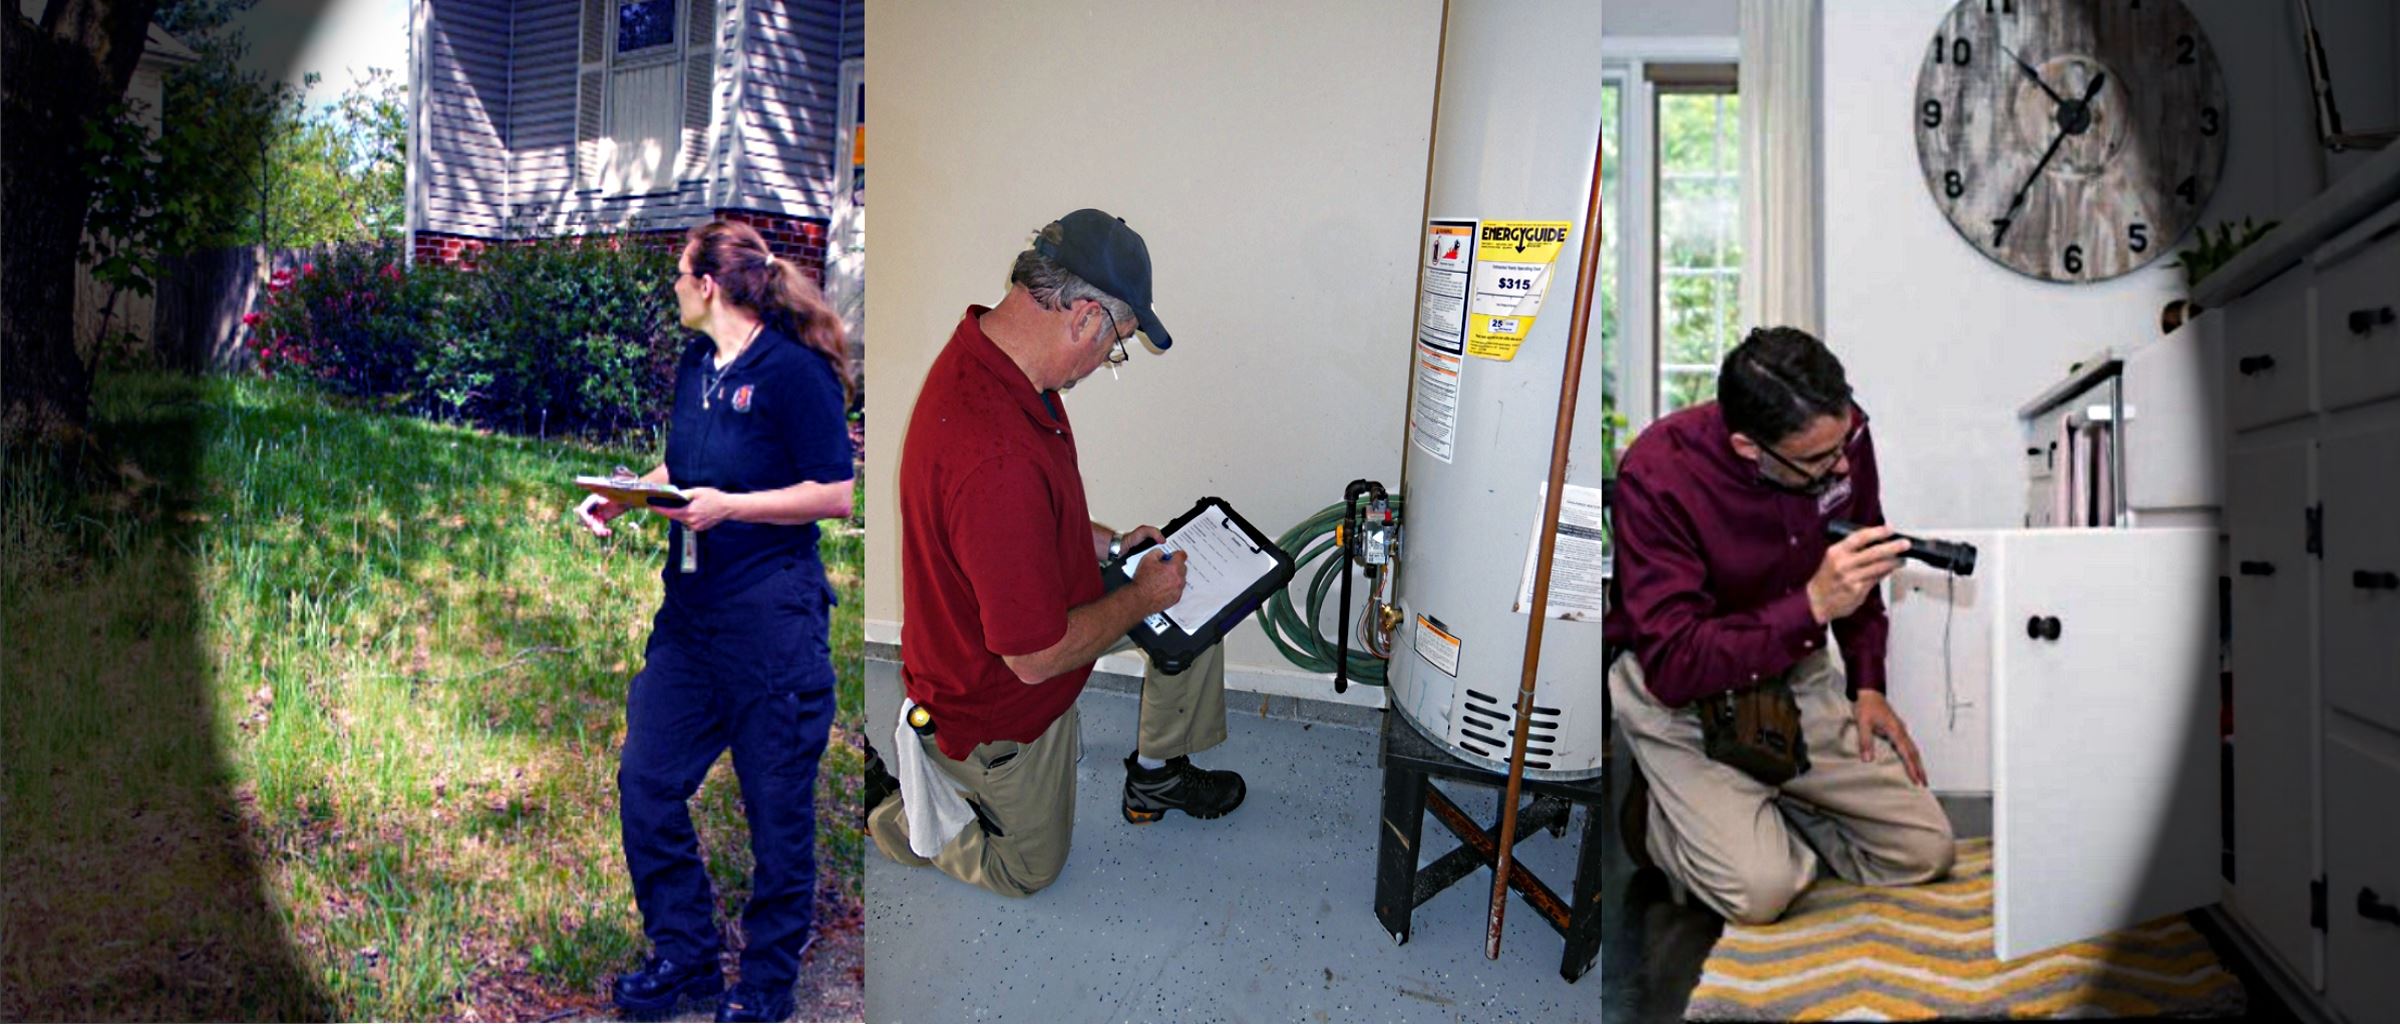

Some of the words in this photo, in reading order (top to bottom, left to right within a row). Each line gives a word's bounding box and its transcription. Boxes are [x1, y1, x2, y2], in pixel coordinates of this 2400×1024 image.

[1934, 35, 1972, 68] 10
[2175, 33, 2196, 66] 2
[1922, 99, 1942, 128] 9
[2199, 106, 2220, 137] 3
[1944, 170, 1964, 199] 8
[2175, 175, 2197, 205] 4
[1992, 217, 2012, 248] 7
[2128, 224, 2148, 253] 5
[2063, 244, 2083, 274] 6
[1498, 277, 1531, 290] $315
